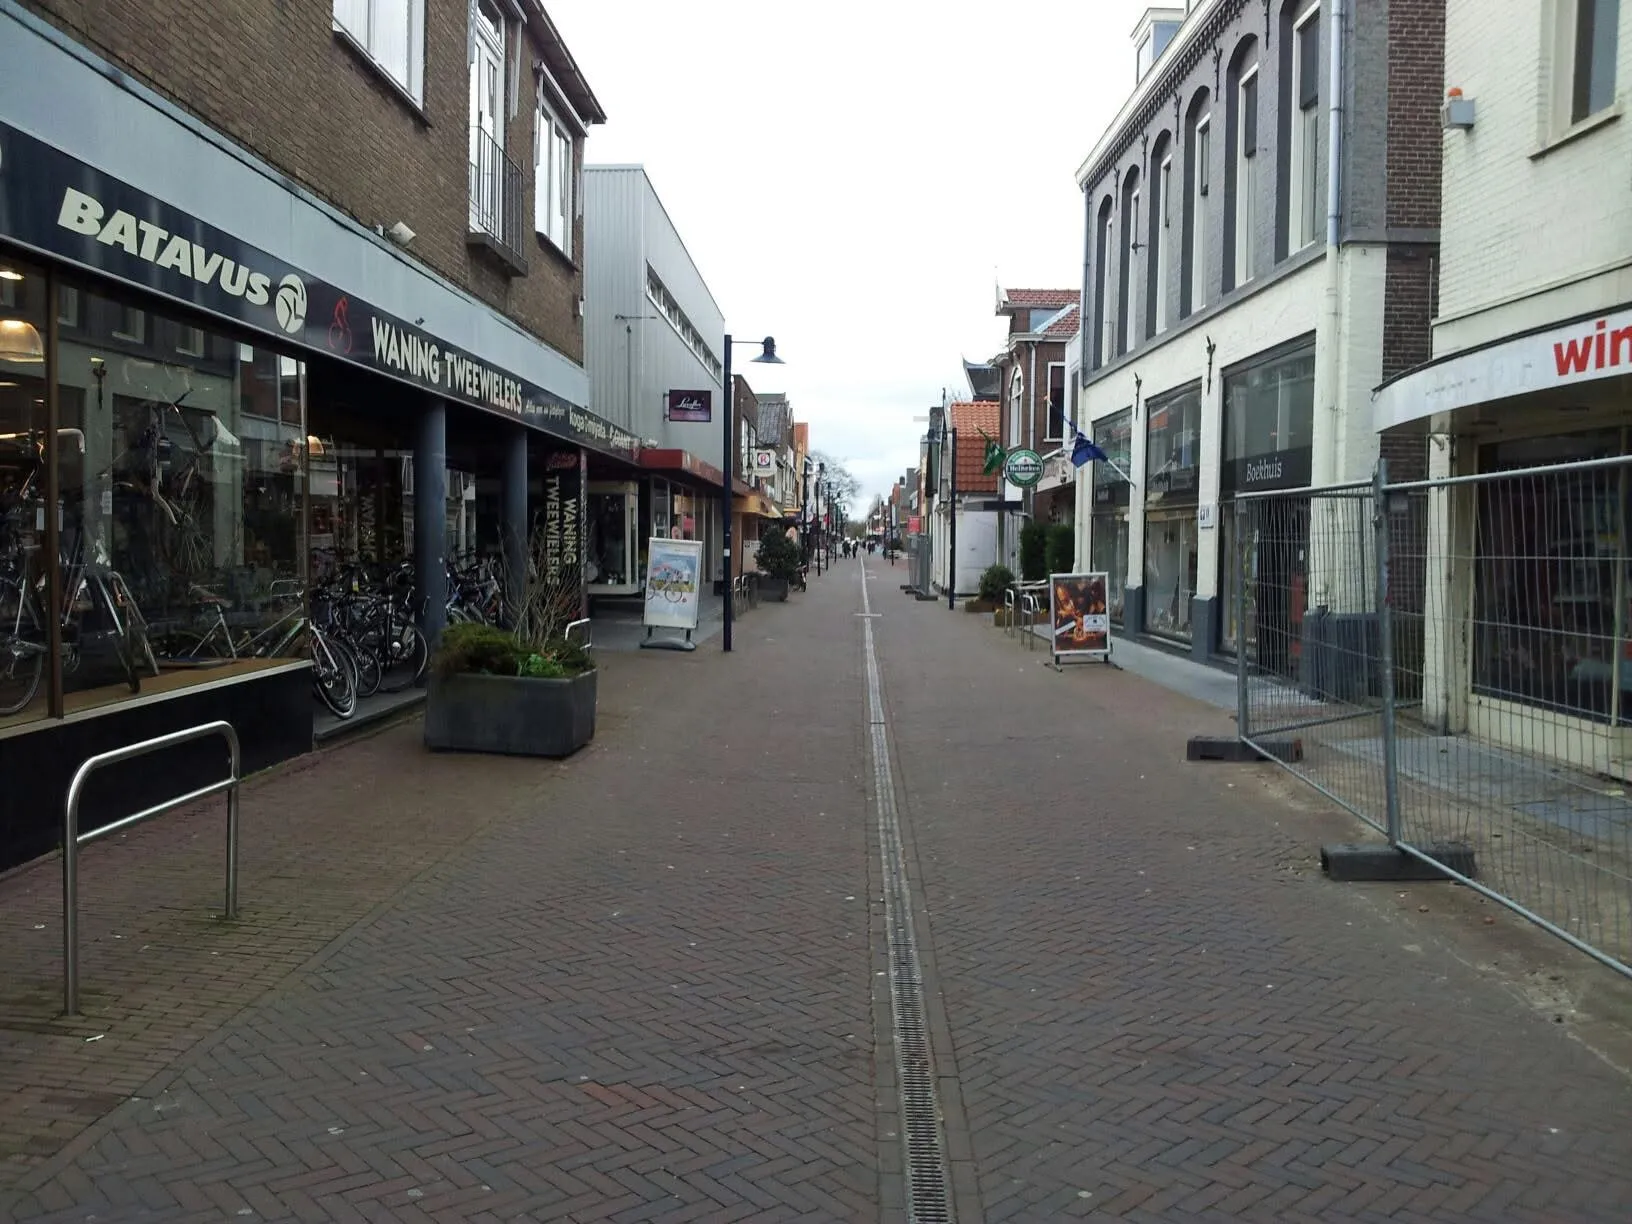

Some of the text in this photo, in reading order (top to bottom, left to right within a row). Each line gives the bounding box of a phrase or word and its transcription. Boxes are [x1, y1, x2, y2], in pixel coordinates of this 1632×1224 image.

[57, 187, 271, 306] BATAVUS
[371, 316, 523, 415] WANING TWEEWIELERS
[1246, 457, 1282, 482] Boekhuis
[563, 498, 577, 565] WANING
